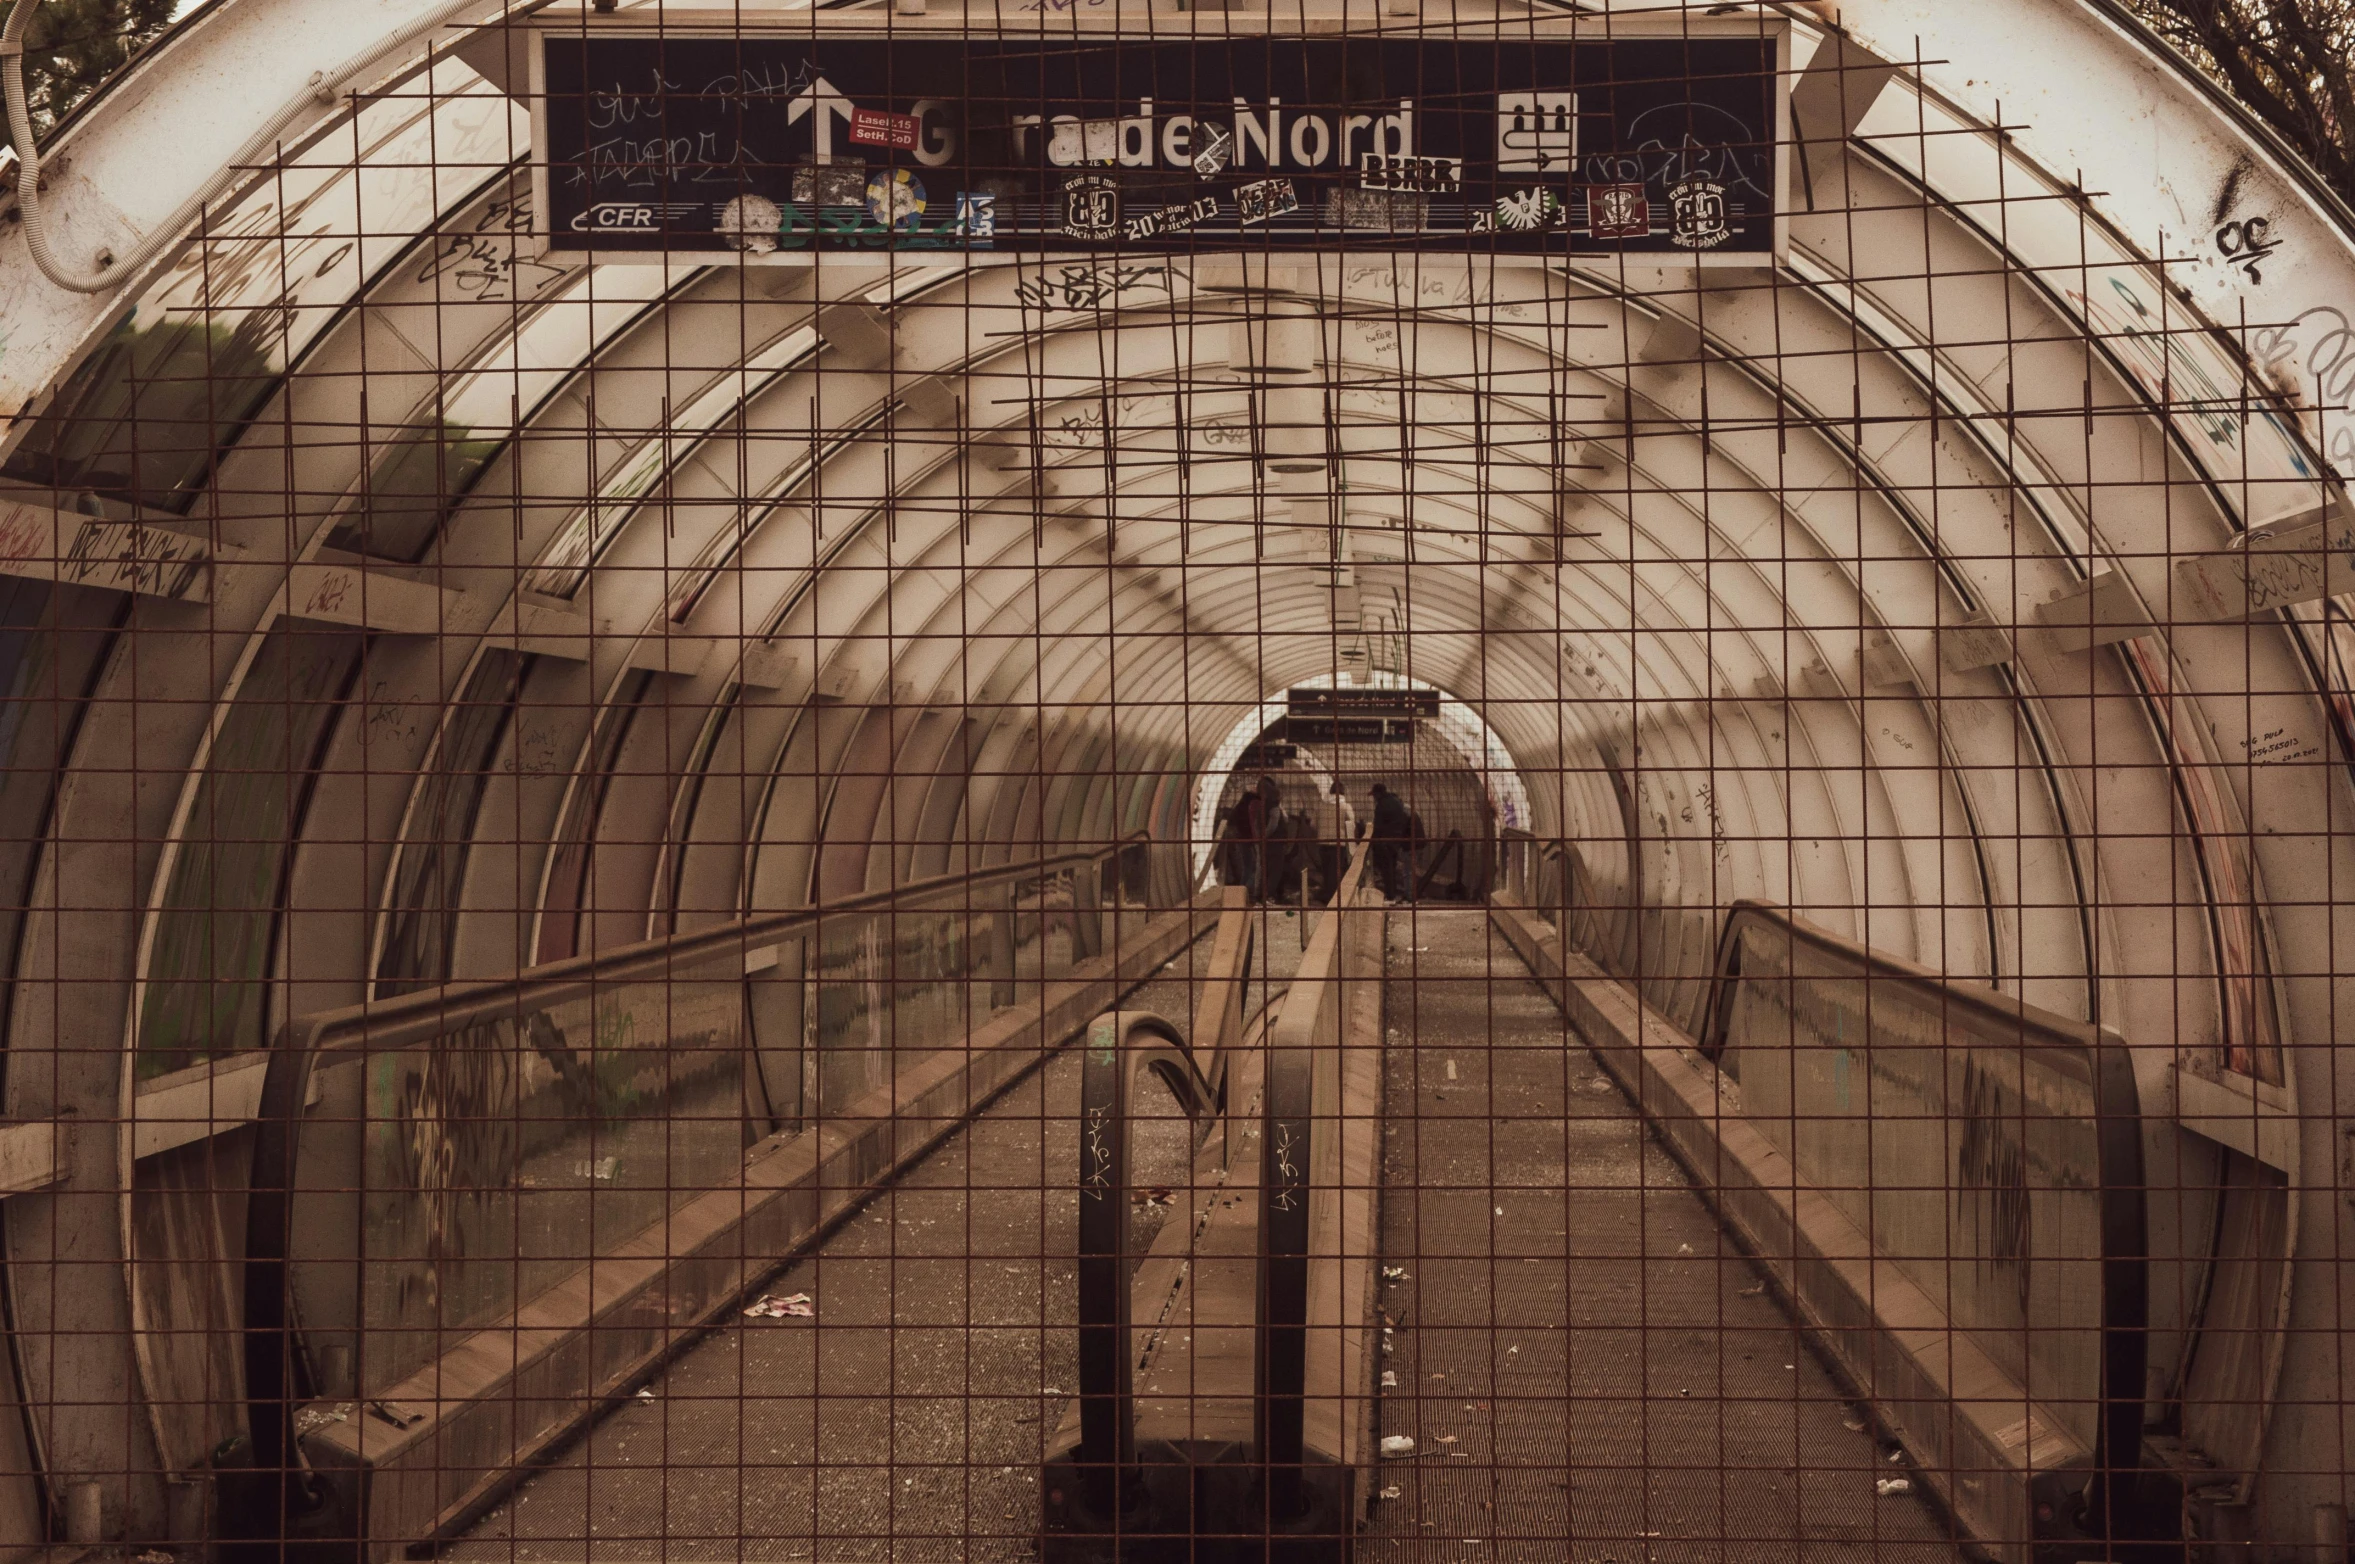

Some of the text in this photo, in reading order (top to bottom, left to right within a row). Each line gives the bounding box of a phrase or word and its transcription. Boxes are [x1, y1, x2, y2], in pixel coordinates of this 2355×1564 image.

[1118, 97, 1198, 167] de
[1232, 96, 1413, 167] Nord
[598, 207, 653, 226] CFR
[1125, 215, 1155, 241] 20
